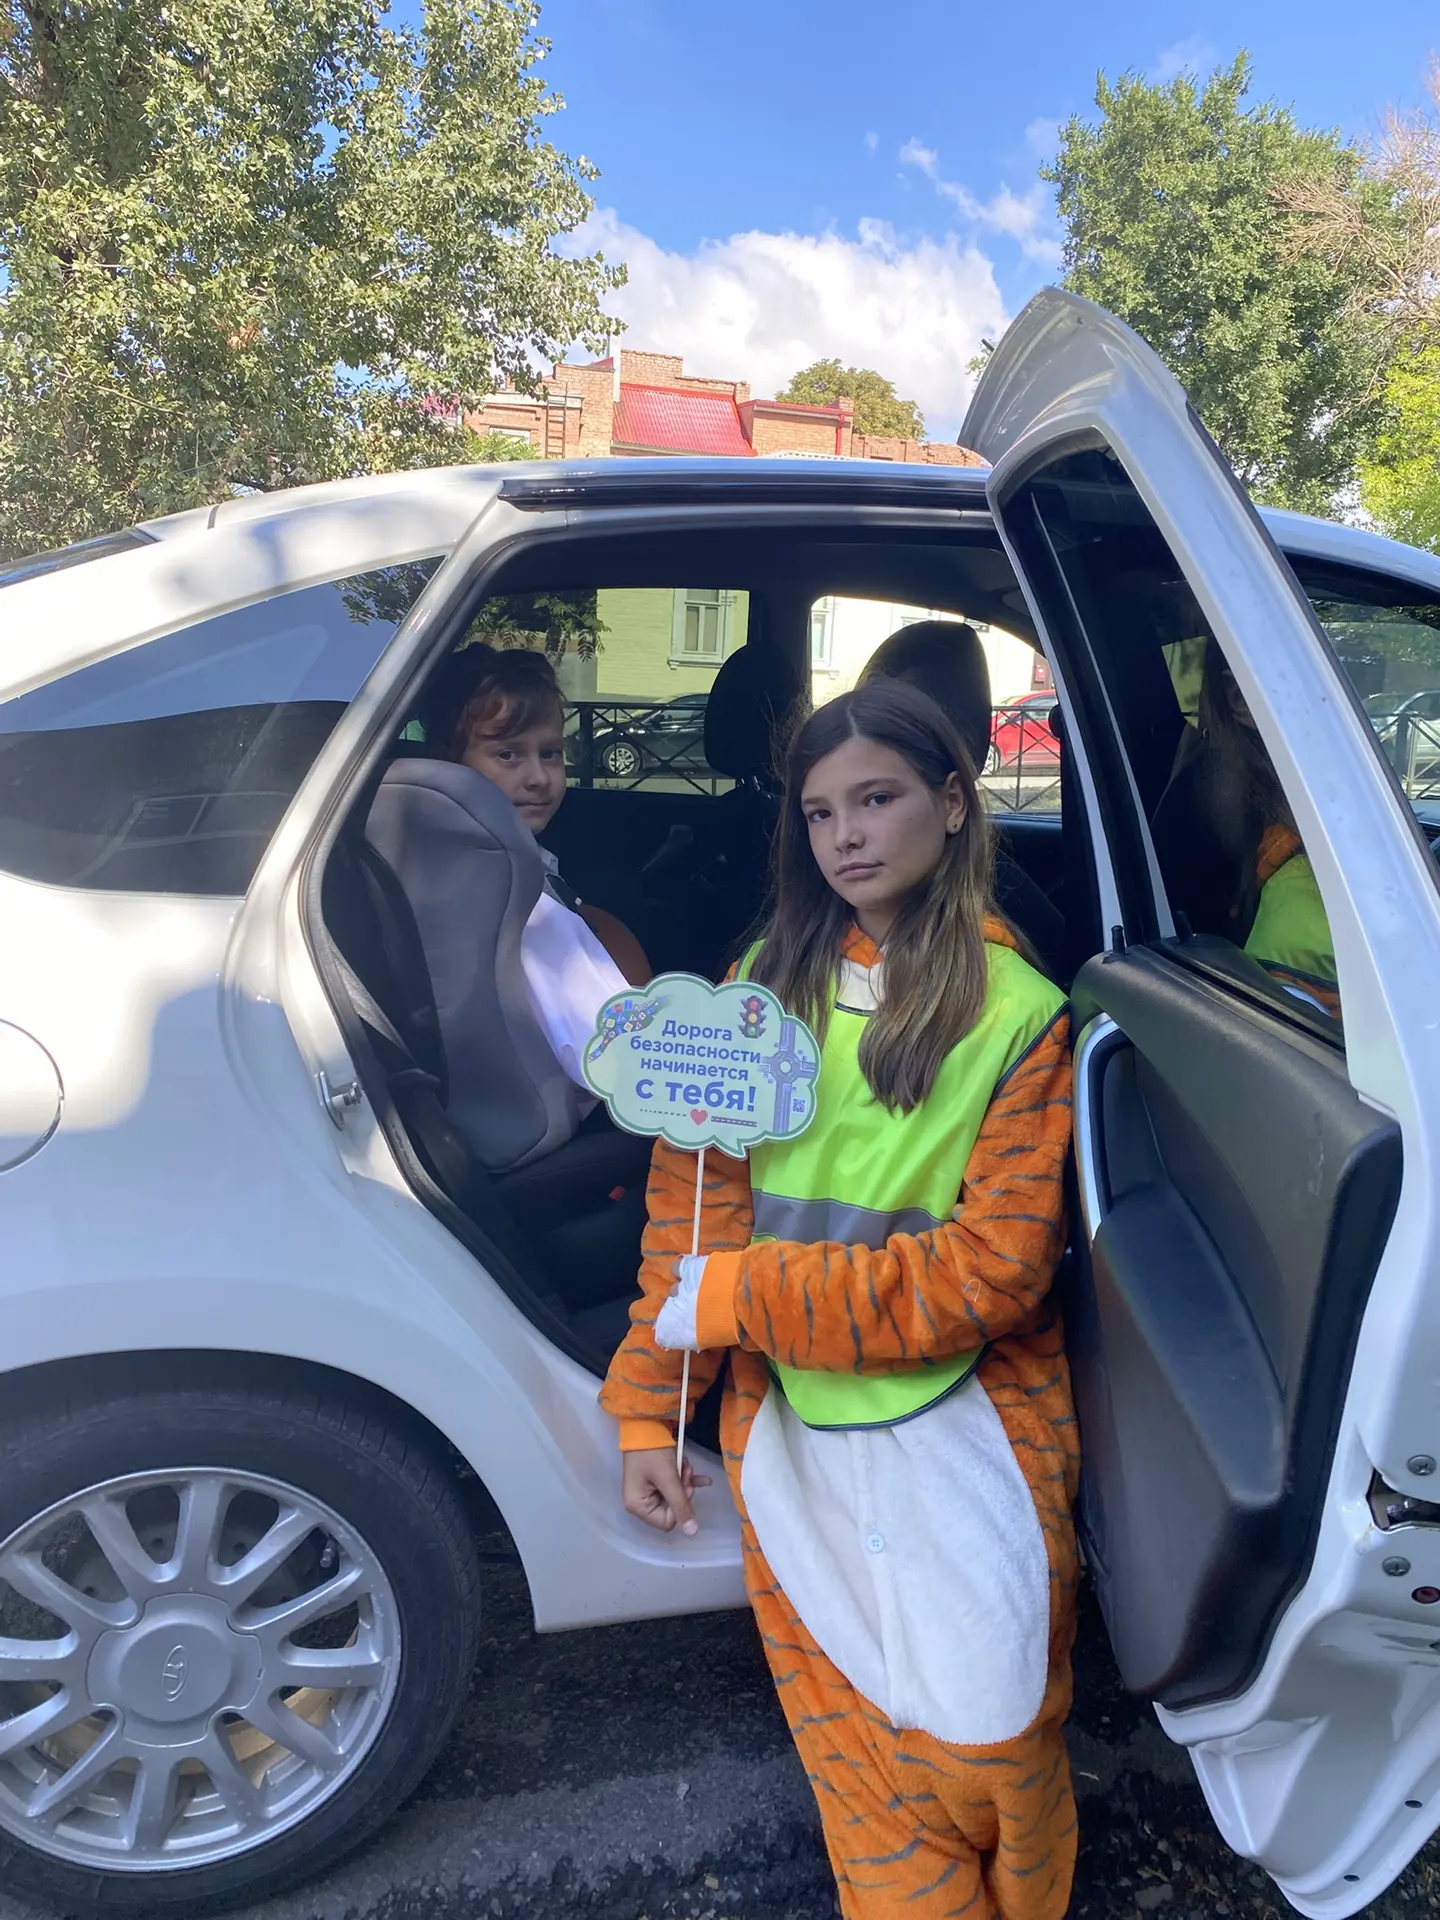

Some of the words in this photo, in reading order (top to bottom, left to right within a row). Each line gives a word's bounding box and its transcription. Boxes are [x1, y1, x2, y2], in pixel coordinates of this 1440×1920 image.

[661, 1020, 732, 1041] Дорога
[630, 1035, 761, 1063] безопасности
[640, 1057, 749, 1081] начинается
[635, 1079, 654, 1099] с
[665, 1081, 757, 1112] тебя!
